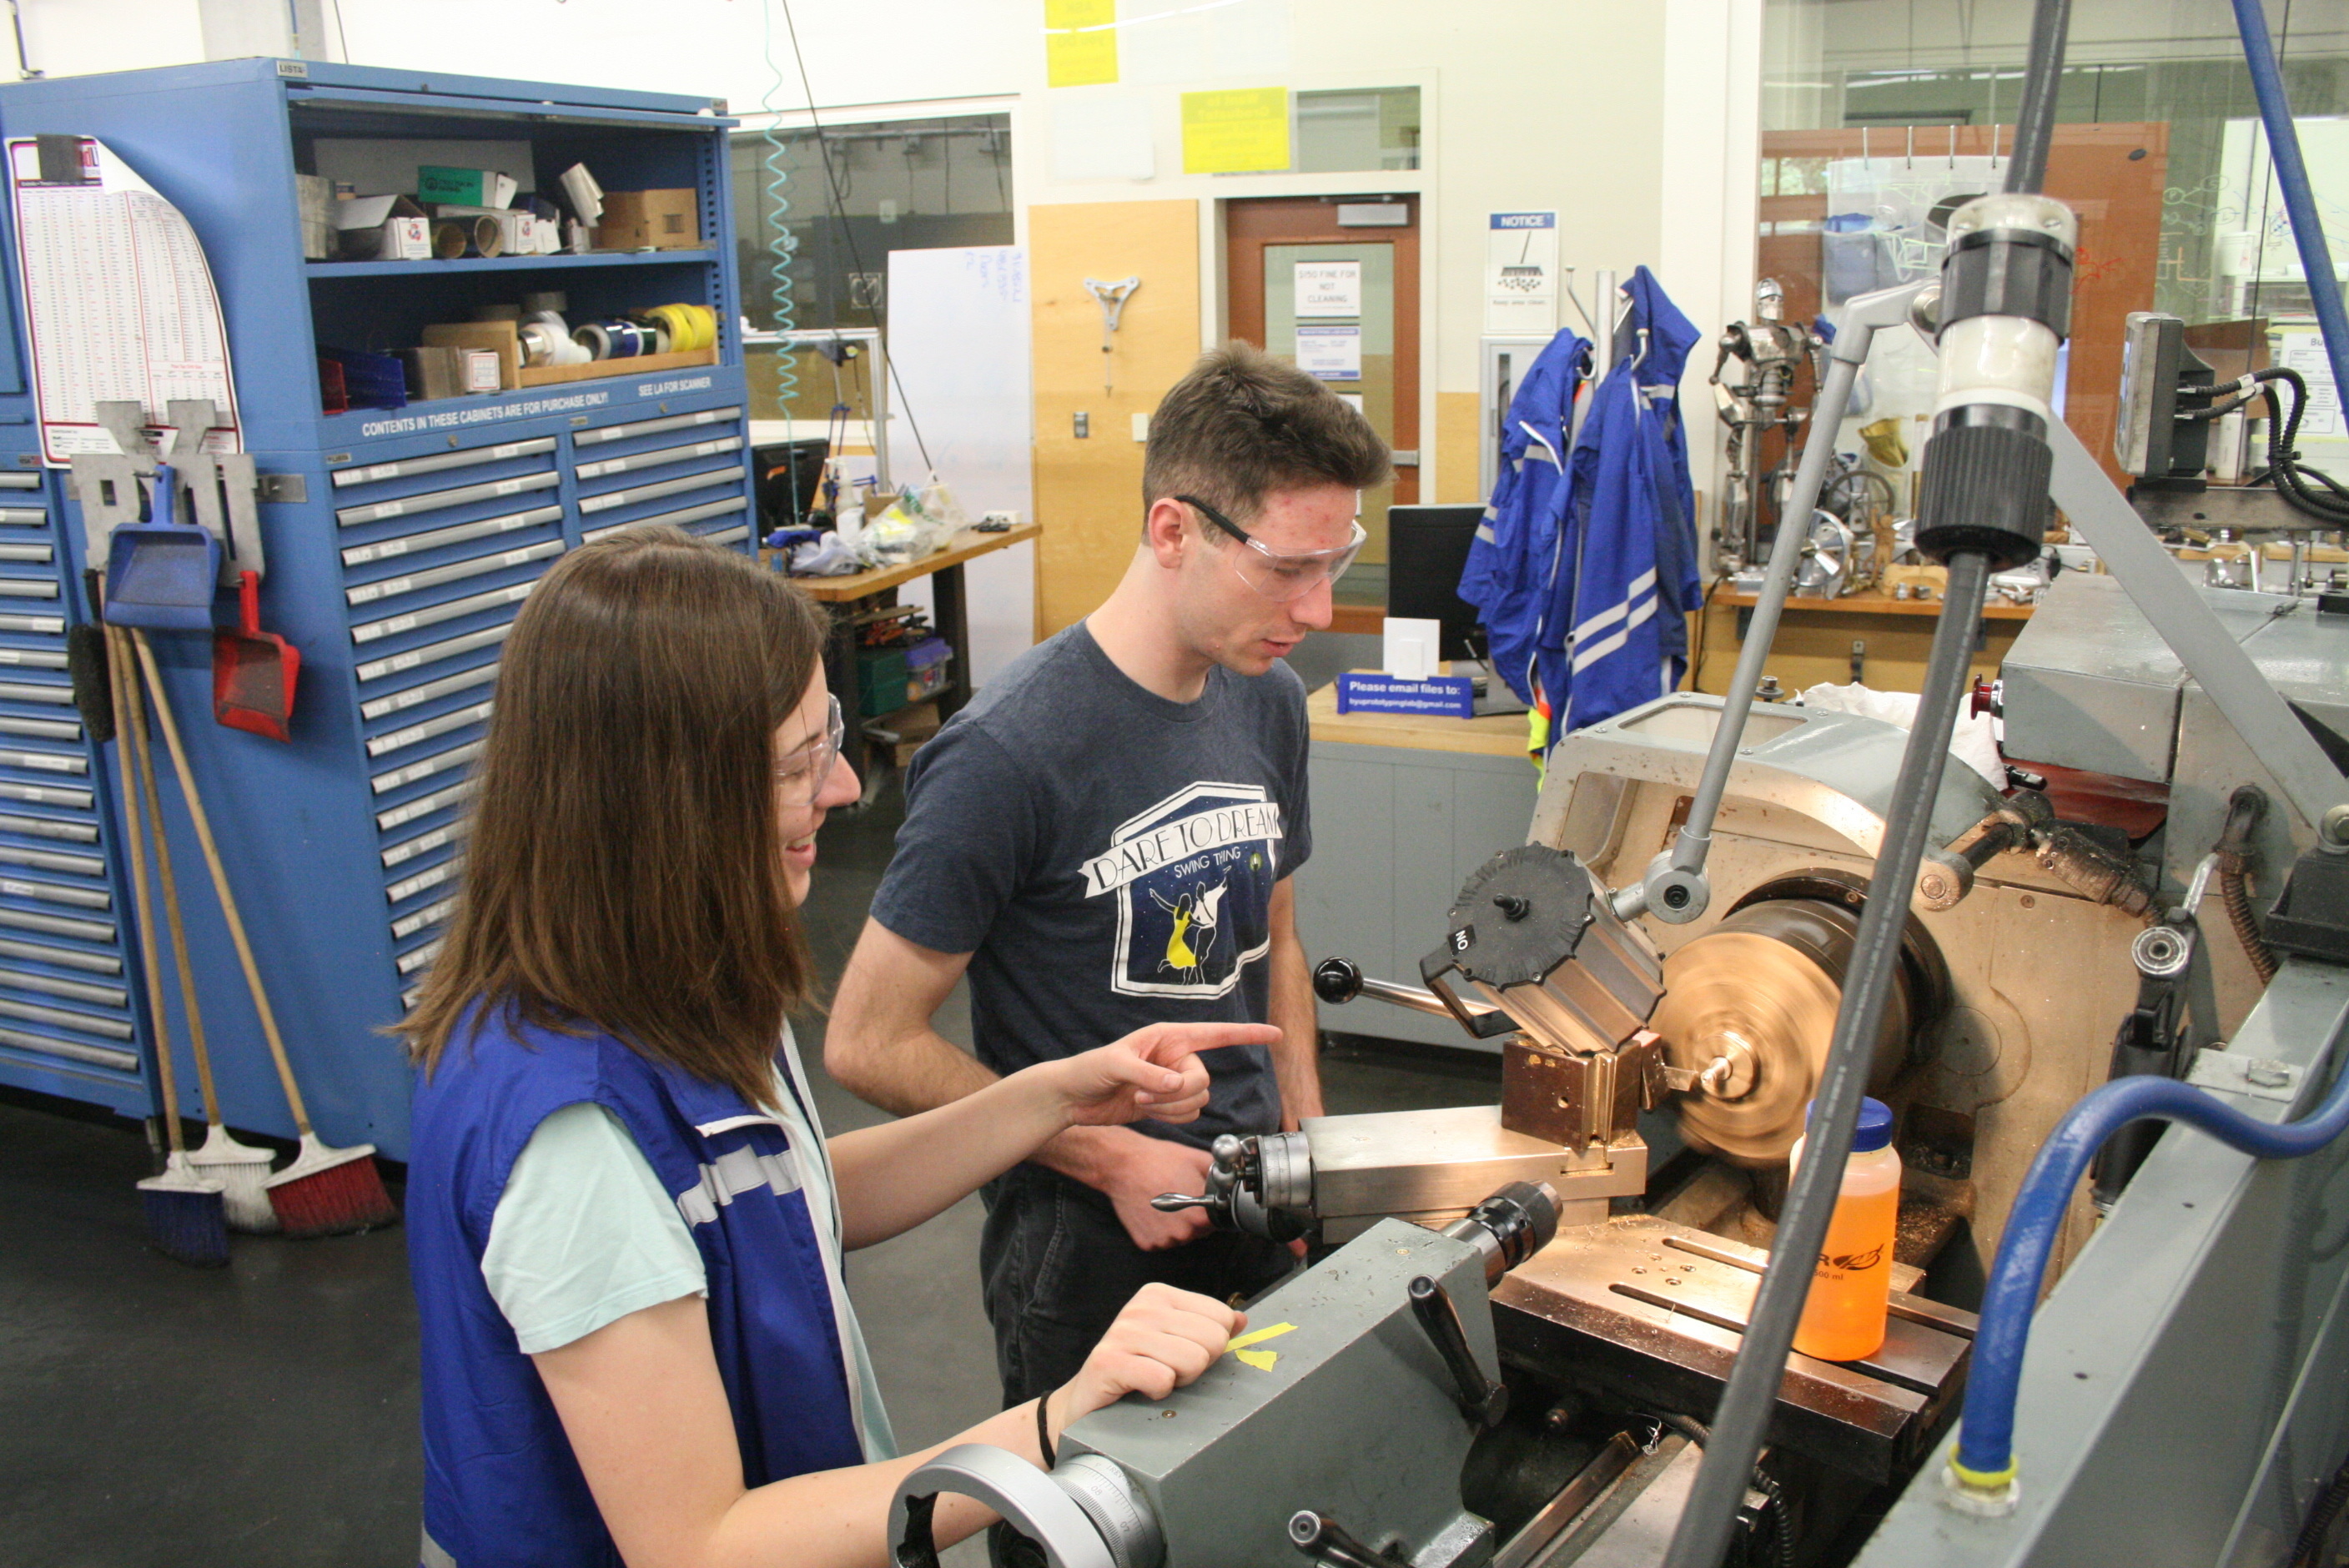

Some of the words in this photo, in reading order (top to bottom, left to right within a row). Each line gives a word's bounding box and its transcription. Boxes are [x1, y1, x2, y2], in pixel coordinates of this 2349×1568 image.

[279, 65, 303, 73] LISTA
[1501, 215, 1545, 227] NOTICE
[1320, 269, 1337, 279] FINE
[1340, 269, 1356, 278] FOR
[1307, 294, 1348, 303] CLEANING
[638, 384, 653, 397] SEE
[653, 383, 664, 395] LA
[664, 381, 680, 393] FOR
[679, 376, 712, 391] SCANNER
[362, 418, 415, 437] CONTENTS
[416, 416, 427, 430] IN
[429, 411, 460, 428] THESE
[460, 405, 504, 424] CABINETS
[505, 404, 523, 417] ARE
[524, 401, 541, 415] FOR
[541, 395, 586, 412] PURCHASE
[586, 392, 609, 406] ONLY!
[1350, 681, 1386, 692] Please
[1388, 683, 1419, 693] email
[1421, 684, 1444, 694] files
[1446, 685, 1461, 695] to:
[1093, 830, 1174, 890] DARE
[1174, 817, 1213, 852] TO
[1217, 806, 1280, 842] DREAM
[1174, 855, 1210, 878] SWING
[1213, 846, 1241, 866] THING
